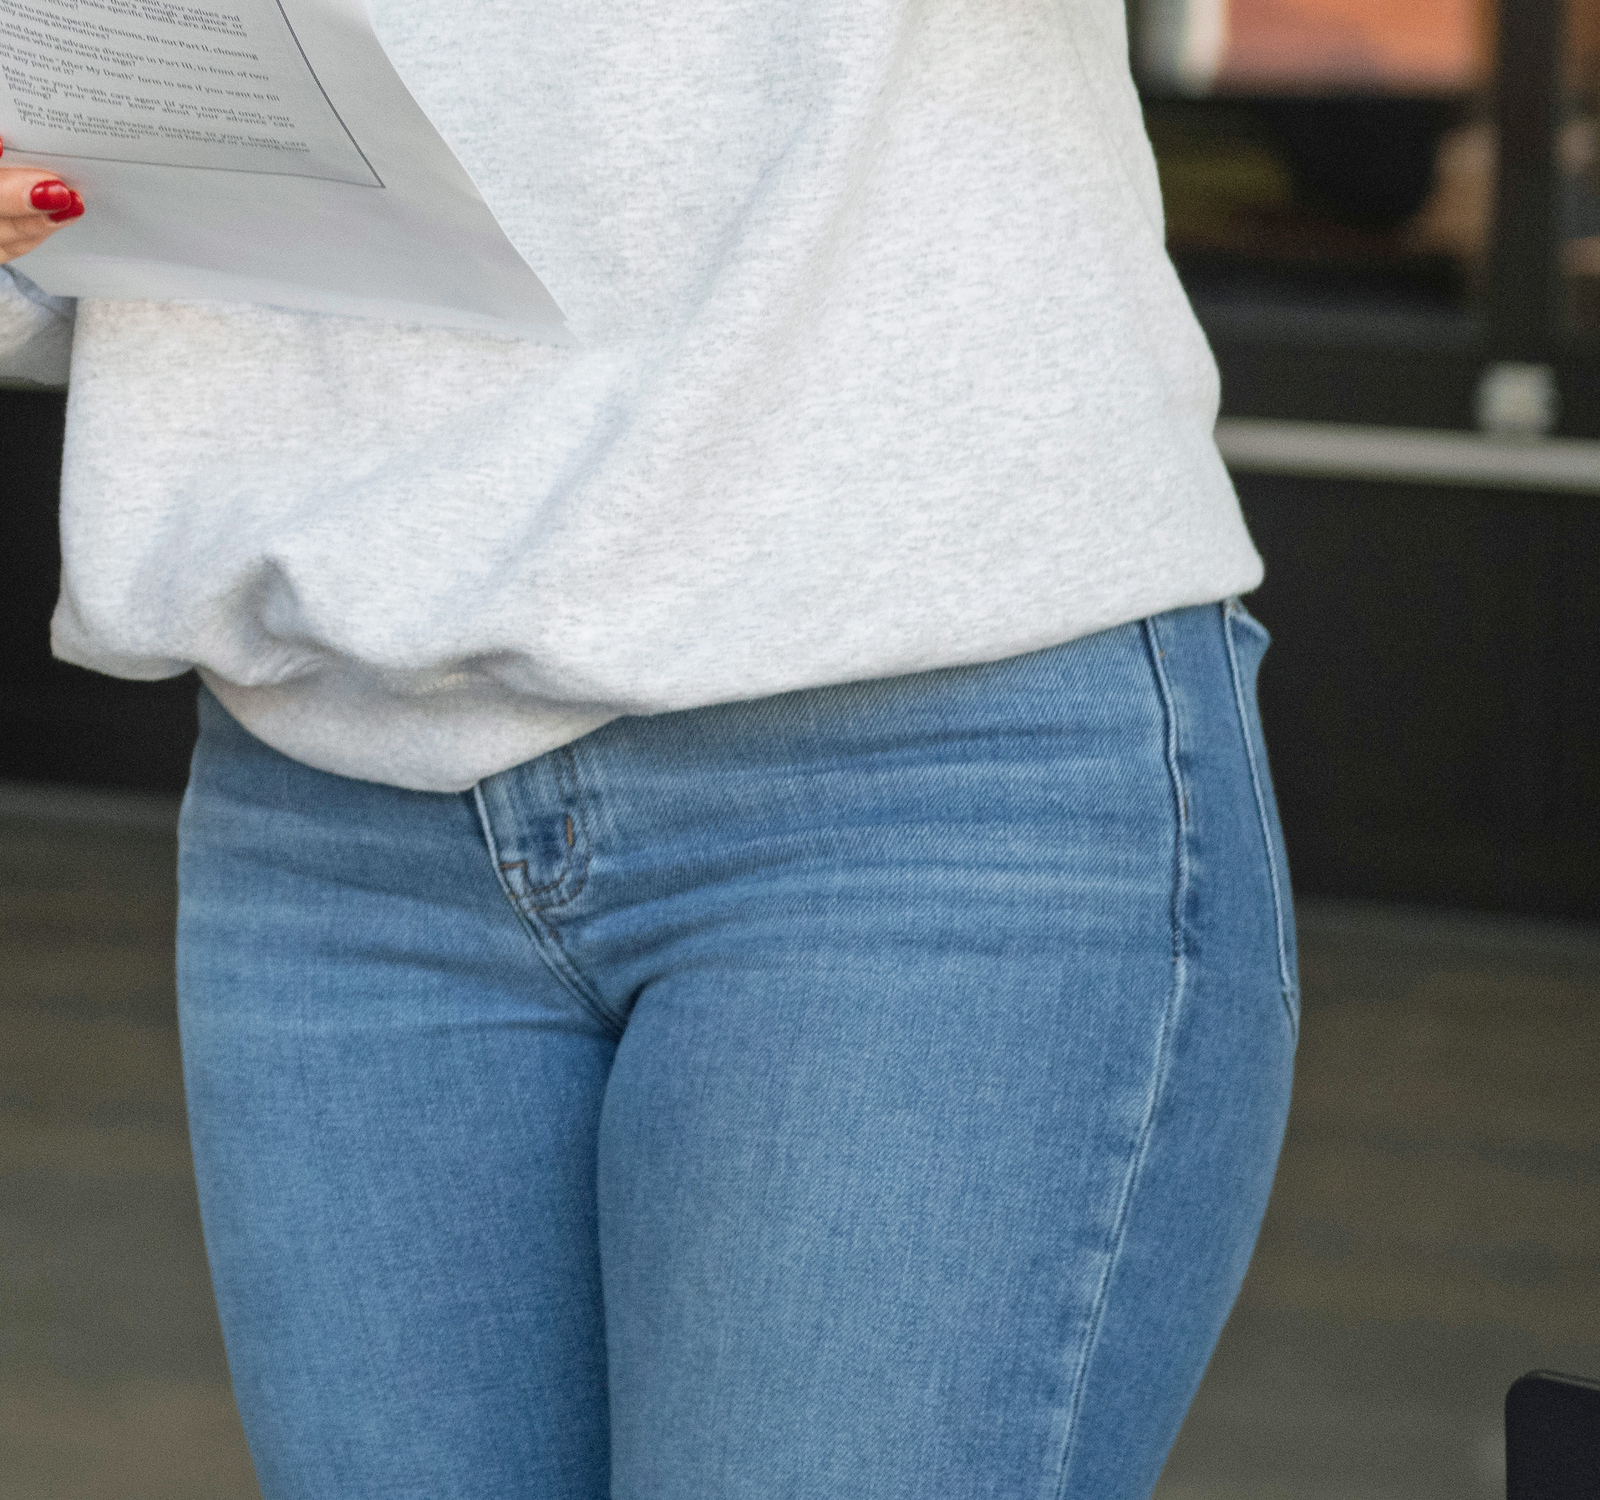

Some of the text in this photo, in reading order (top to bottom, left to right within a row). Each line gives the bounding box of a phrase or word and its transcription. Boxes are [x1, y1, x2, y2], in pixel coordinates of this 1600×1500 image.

[79, 0, 105, 9] make
[108, 6, 141, 17] specific
[144, 12, 176, 24] health
[201, 24, 247, 37] decisions
[142, 6, 178, 18] enough
[183, 15, 225, 26] guidance
[163, 3, 184, 11] your
[187, 8, 219, 18] values
[1, 0, 23, 9] want
[36, 10, 60, 20] make
[62, 18, 95, 29] specific
[178, 41, 199, 50] Part
[213, 48, 259, 61] choosing
[19, 13, 50, 26] among
[52, 22, 109, 39] alternatives?
[23, 27, 41, 37] date
[64, 40, 100, 52] advance
[102, 48, 144, 61] directive
[158, 58, 179, 67] Part
[209, 67, 234, 76] front
[249, 73, 269, 81] two
[31, 61, 50, 69] part
[32, 38, 52, 48] who
[54, 44, 73, 53] also
[75, 50, 98, 59] need
[112, 58, 136, 66] sign?
[17, 49, 36, 58] over
[85, 65, 100, 75] My
[137, 76, 162, 85] form
